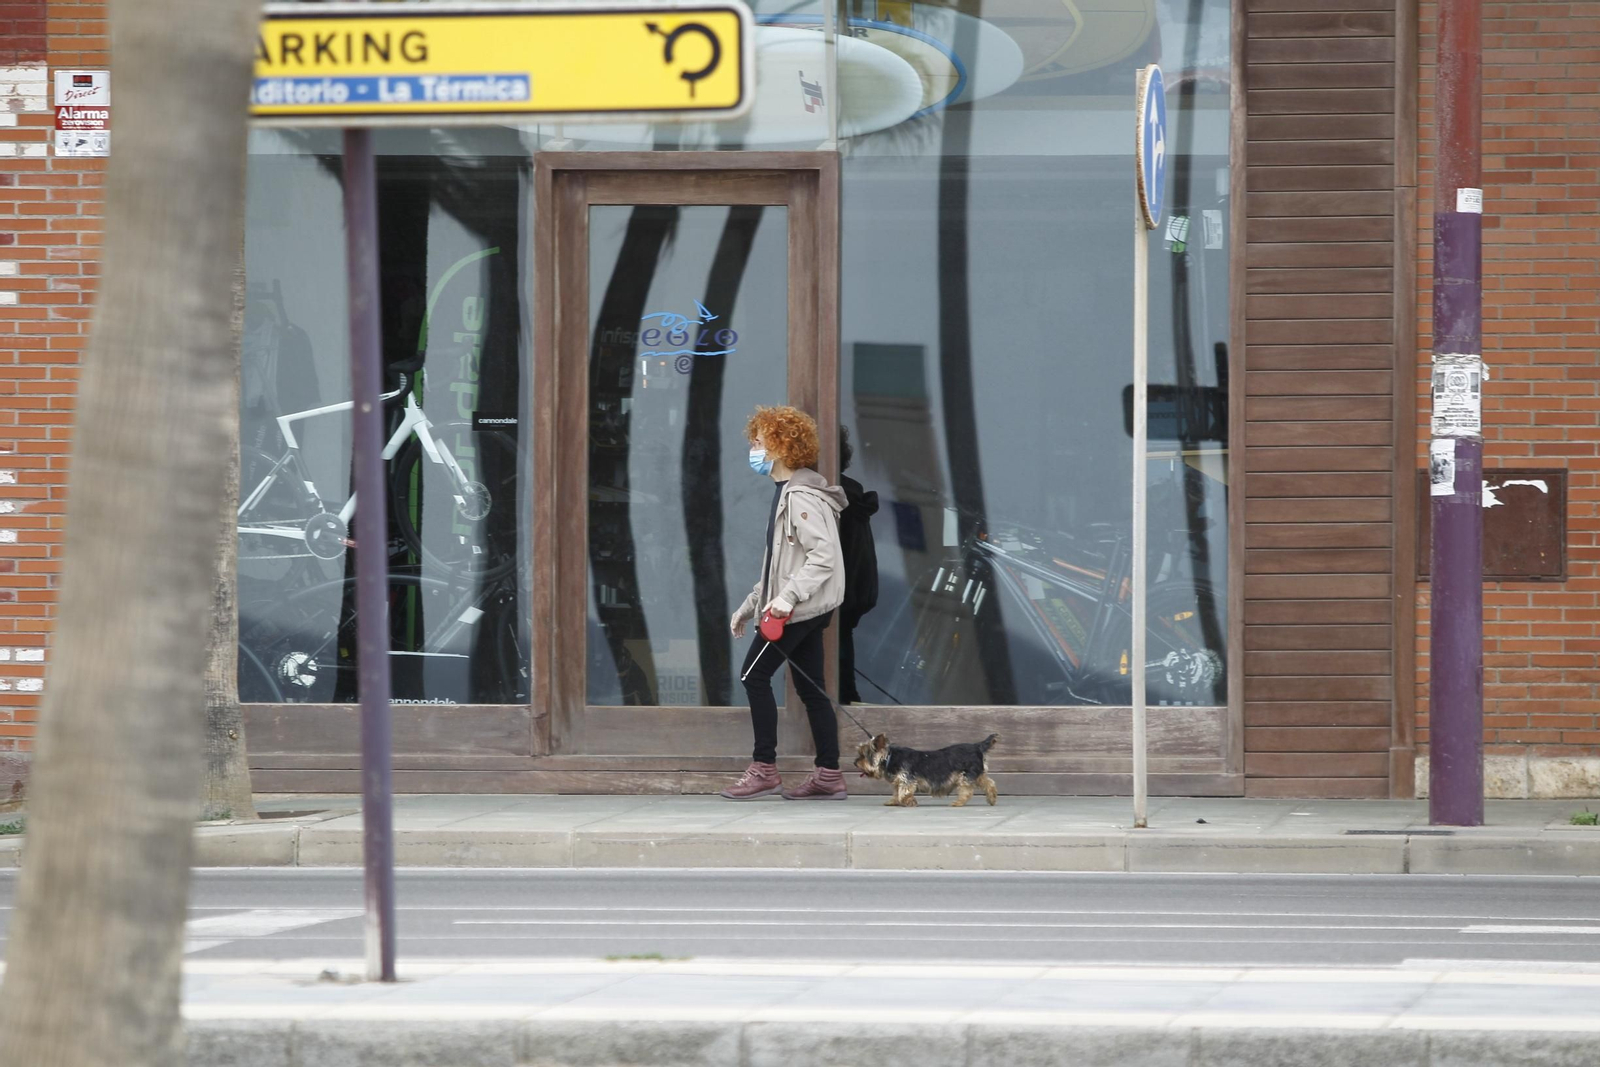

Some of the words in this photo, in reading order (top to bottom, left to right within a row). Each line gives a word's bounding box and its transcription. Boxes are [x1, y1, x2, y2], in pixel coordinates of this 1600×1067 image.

[378, 77, 412, 102] La
[419, 75, 528, 101] Térmica
[58, 107, 109, 119] Alarma
[656, 675, 697, 691] RIDE
